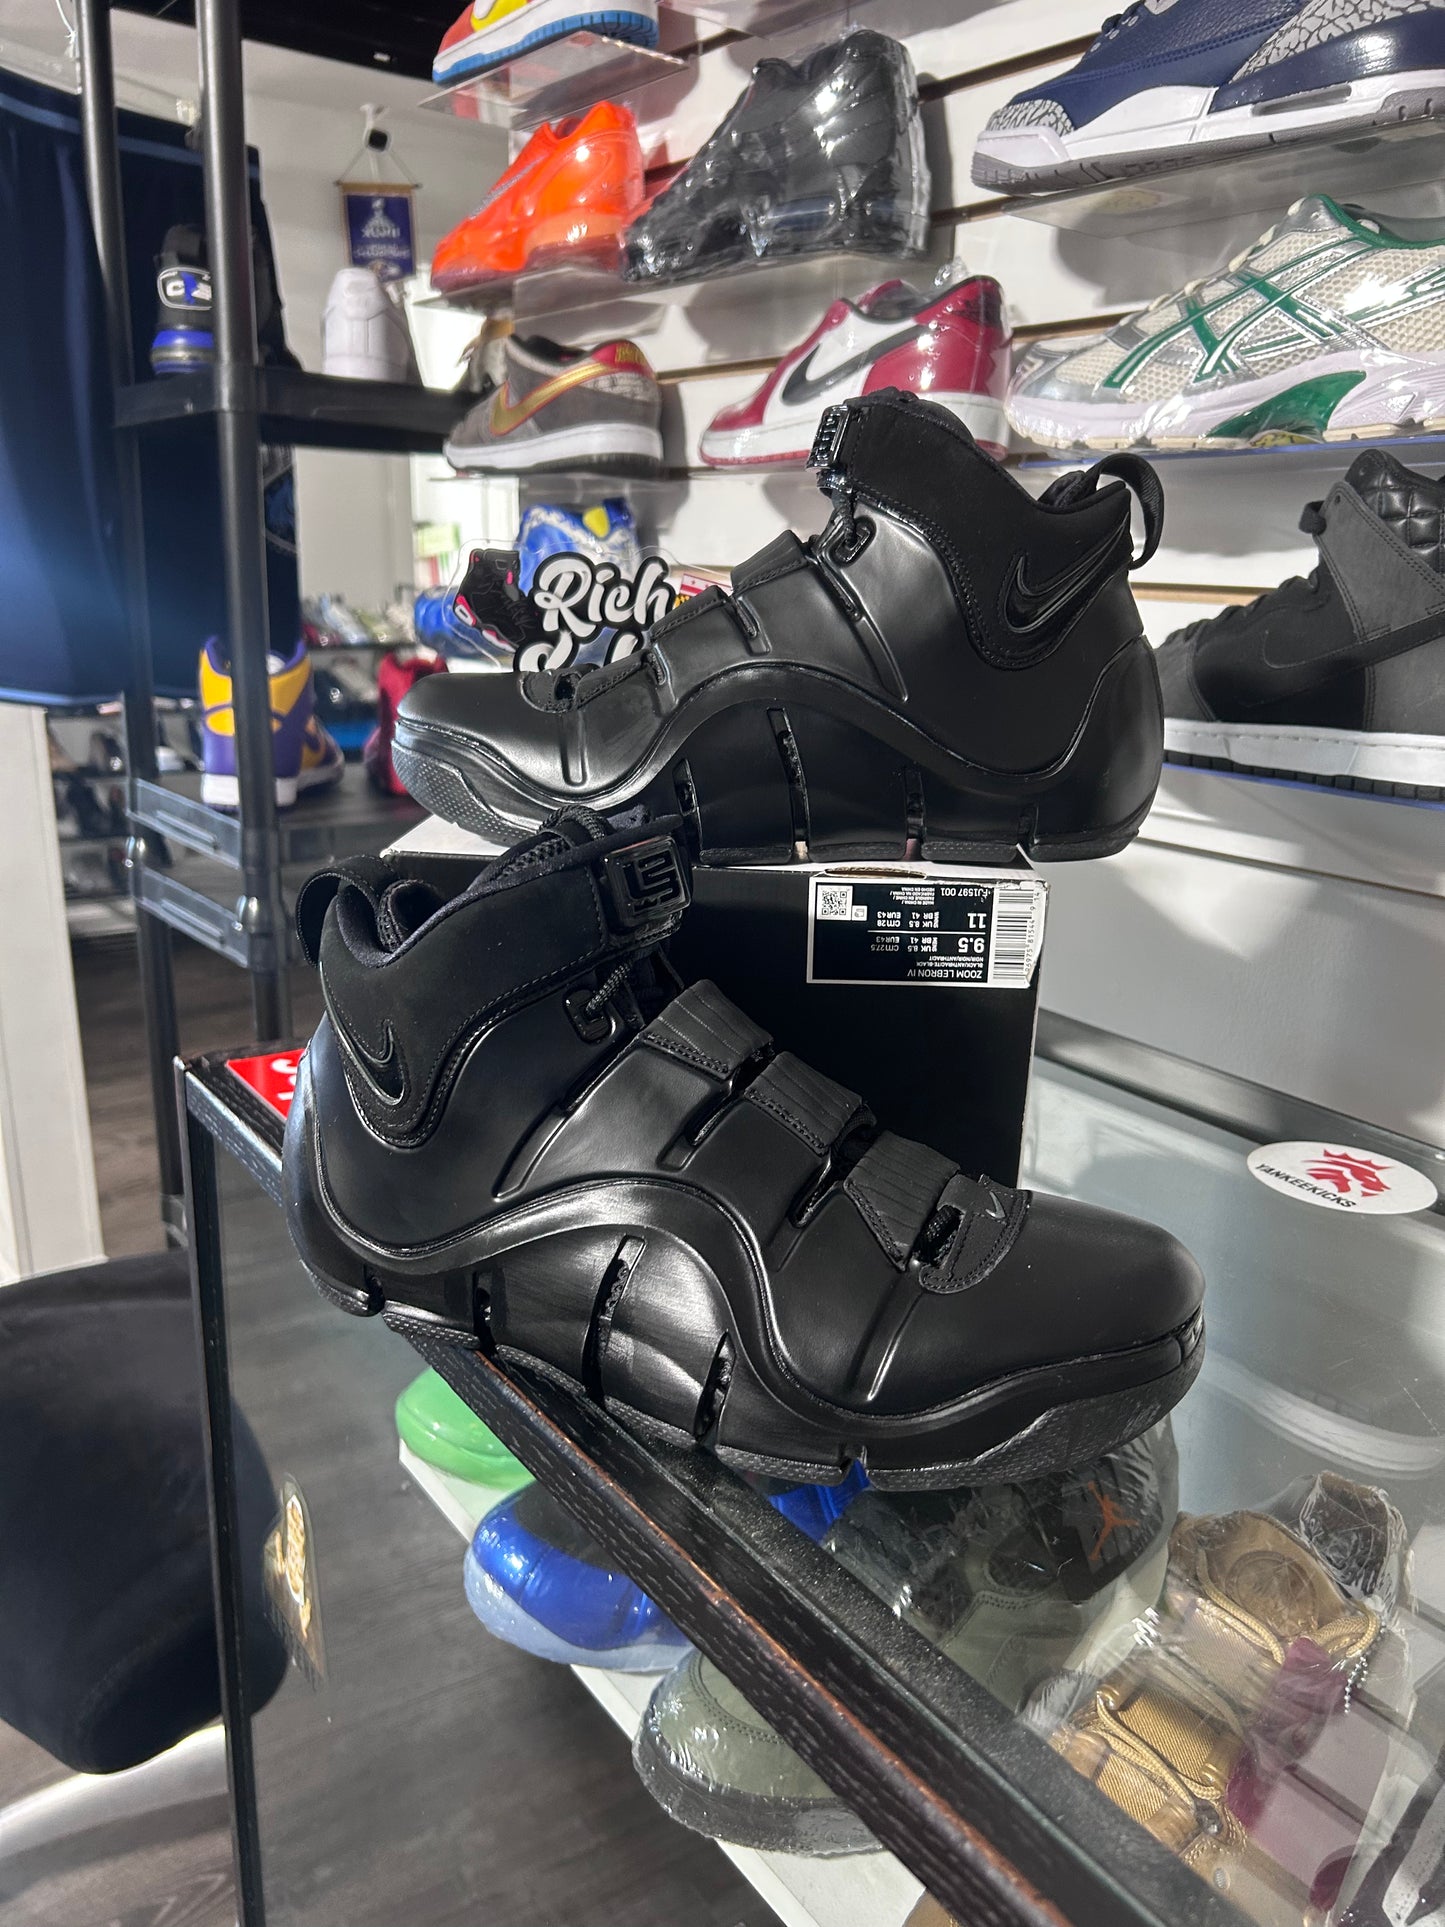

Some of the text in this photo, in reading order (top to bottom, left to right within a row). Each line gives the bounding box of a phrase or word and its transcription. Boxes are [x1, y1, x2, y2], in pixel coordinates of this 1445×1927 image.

[533, 557, 669, 637] Rich
[941, 888, 988, 897] FJ1597 001
[967, 913, 987, 928] 11
[958, 937, 984, 953] 9.5
[918, 969, 954, 978] LEBRON
[956, 969, 982, 978] ZOOM
[1254, 1162, 1357, 1208] YANKEEKICKS
